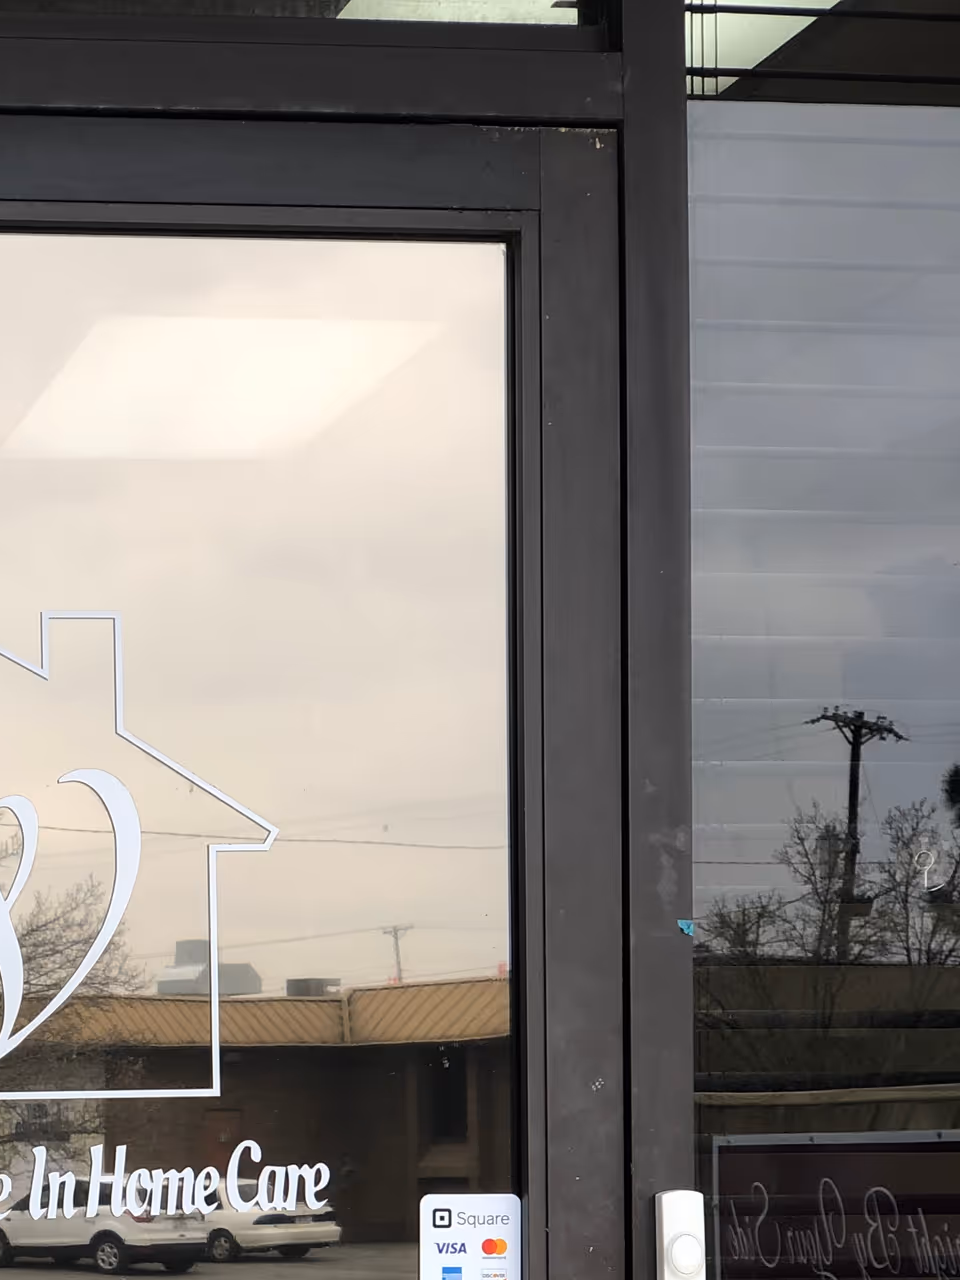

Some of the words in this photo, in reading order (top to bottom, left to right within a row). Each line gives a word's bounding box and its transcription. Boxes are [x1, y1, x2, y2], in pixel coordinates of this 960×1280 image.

[30, 1145, 78, 1220] In
[85, 1143, 220, 1218] Home
[226, 1139, 331, 1212] Care
[456, 1211, 510, 1228] Square
[434, 1242, 467, 1254] VISA
